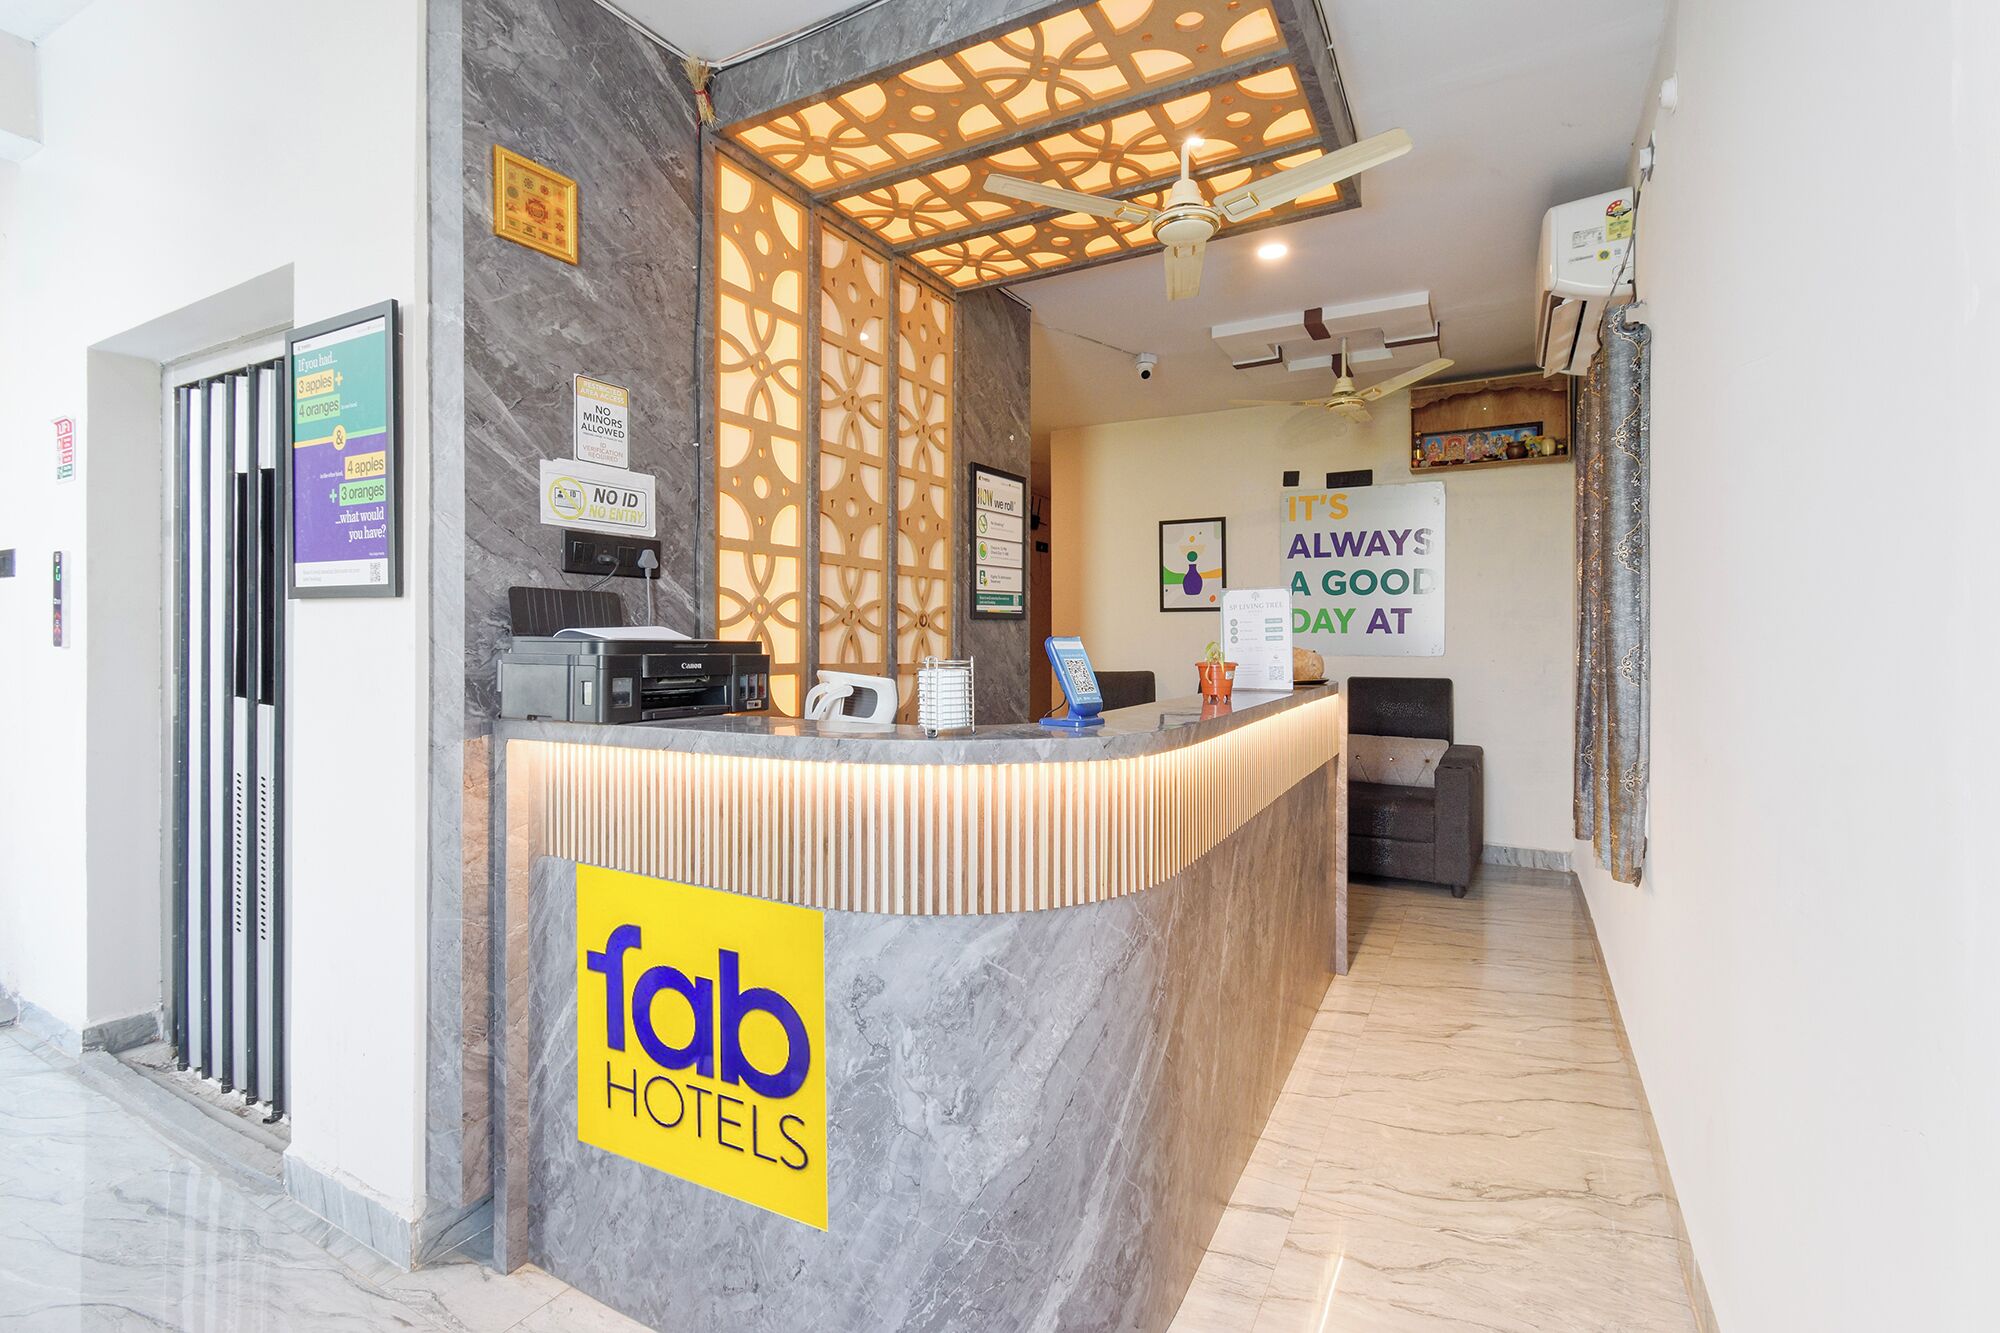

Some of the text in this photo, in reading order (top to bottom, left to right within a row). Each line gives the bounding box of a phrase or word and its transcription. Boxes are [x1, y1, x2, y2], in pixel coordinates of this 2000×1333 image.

[298, 380, 305, 394] 3
[305, 375, 333, 394] apples
[299, 404, 305, 417] 4
[306, 399, 339, 417] oranges
[595, 405, 611, 417] NO
[583, 411, 623, 429] MINORS
[335, 430, 343, 445] &
[581, 422, 625, 439] ALLOWED
[582, 444, 624, 458] VERIFICATION
[347, 460, 353, 474] 4
[354, 457, 384, 476] apples
[341, 487, 347, 500] 3
[349, 484, 385, 501] oranges
[593, 487, 638, 508] NO ID
[977, 487, 993, 507] HOW
[994, 500, 1003, 510] we
[360, 506, 385, 521] would
[589, 505, 644, 524] NO ENTRY
[1289, 493, 1349, 522] IT'S
[348, 524, 387, 543] you have?
[1287, 527, 1434, 559] ALWAYS
[1291, 568, 1436, 596] A GOOD
[1239, 602, 1264, 610] LIVING
[1265, 601, 1283, 609] TREE
[1292, 608, 1357, 634] DAY
[1365, 608, 1412, 634] AT
[681, 662, 702, 670] Canon
[587, 923, 810, 1099] fab
[607, 1061, 809, 1171] HOTELS
